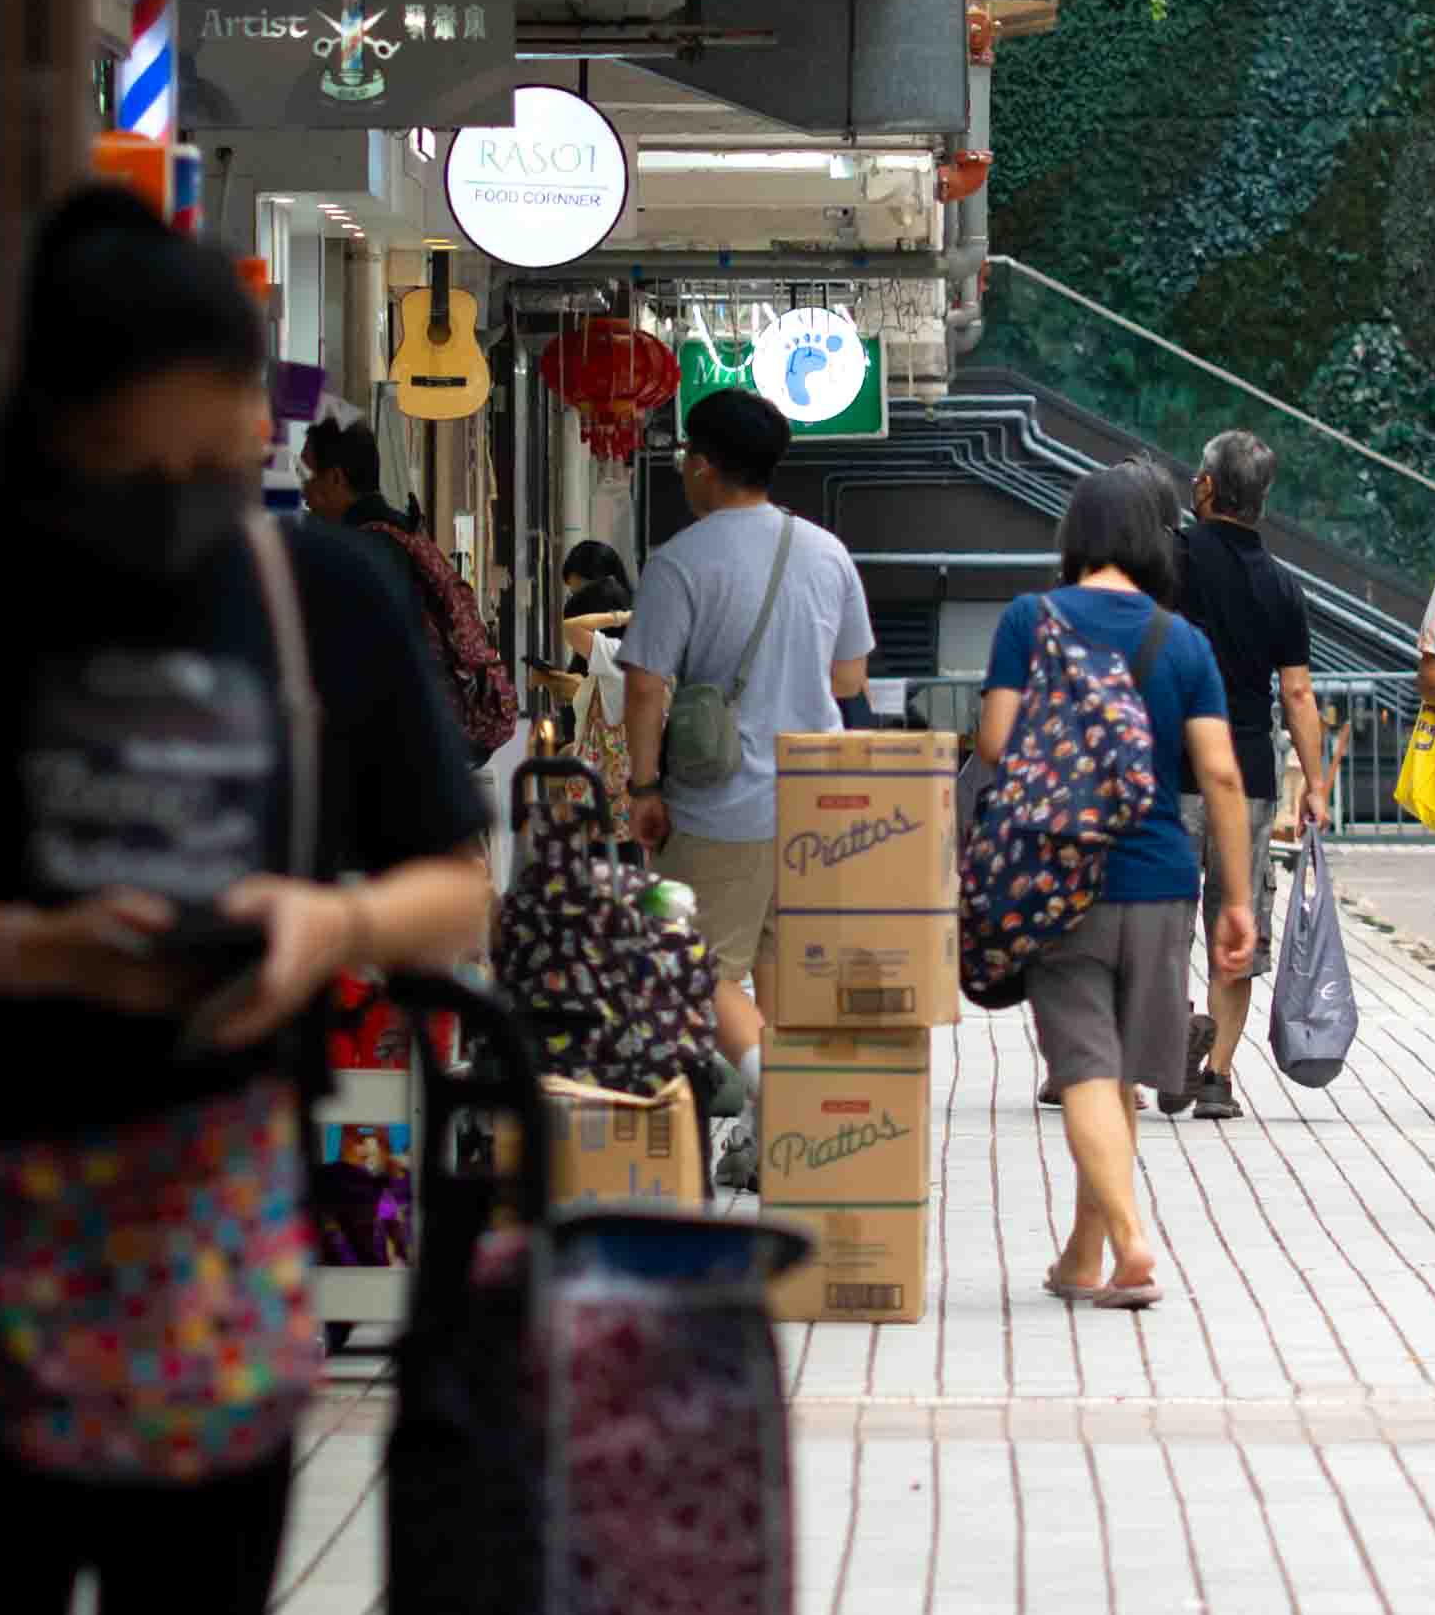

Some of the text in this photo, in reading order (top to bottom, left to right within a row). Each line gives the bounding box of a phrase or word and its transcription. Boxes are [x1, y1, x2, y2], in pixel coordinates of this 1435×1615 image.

[474, 187, 519, 205] FOOD
[784, 805, 925, 876] Piattos
[768, 1109, 912, 1180] Piattos
